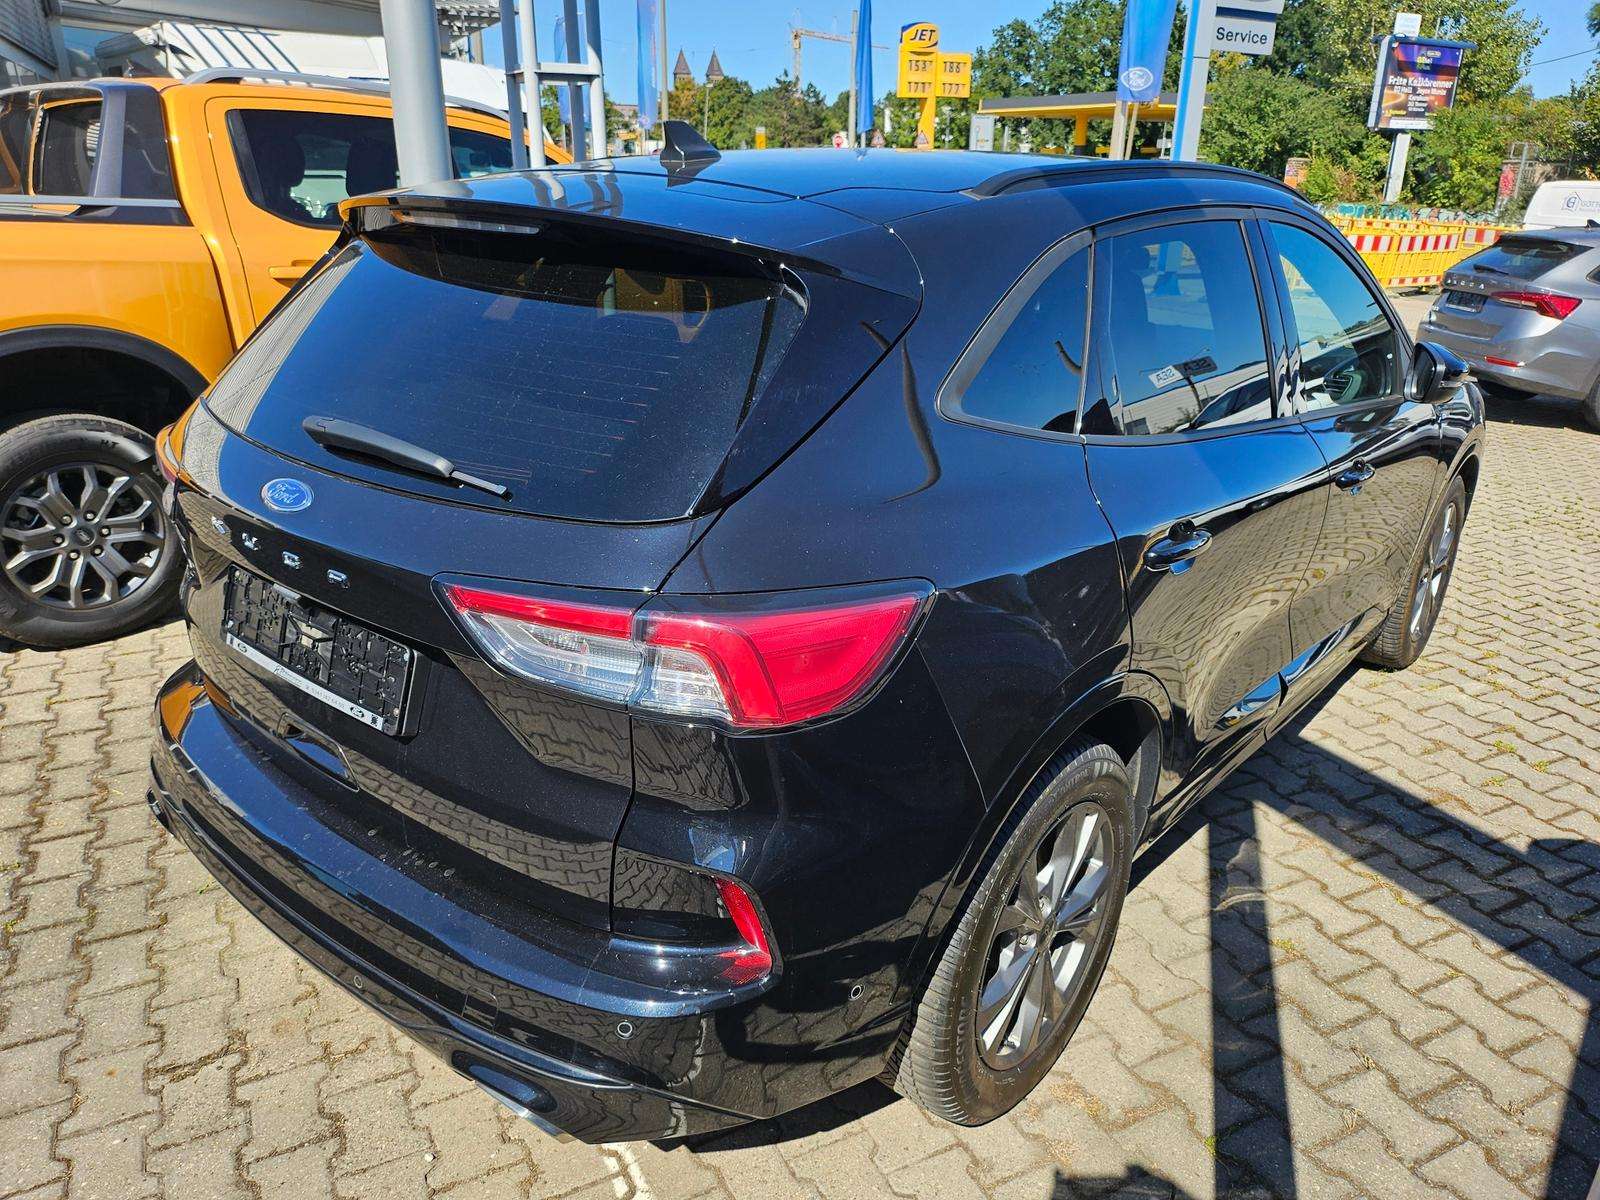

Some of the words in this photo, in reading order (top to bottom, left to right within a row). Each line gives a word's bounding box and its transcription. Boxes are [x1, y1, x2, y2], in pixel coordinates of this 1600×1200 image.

[910, 29, 936, 42] JET
[1216, 27, 1268, 45] Service
[267, 482, 298, 504] Ford
